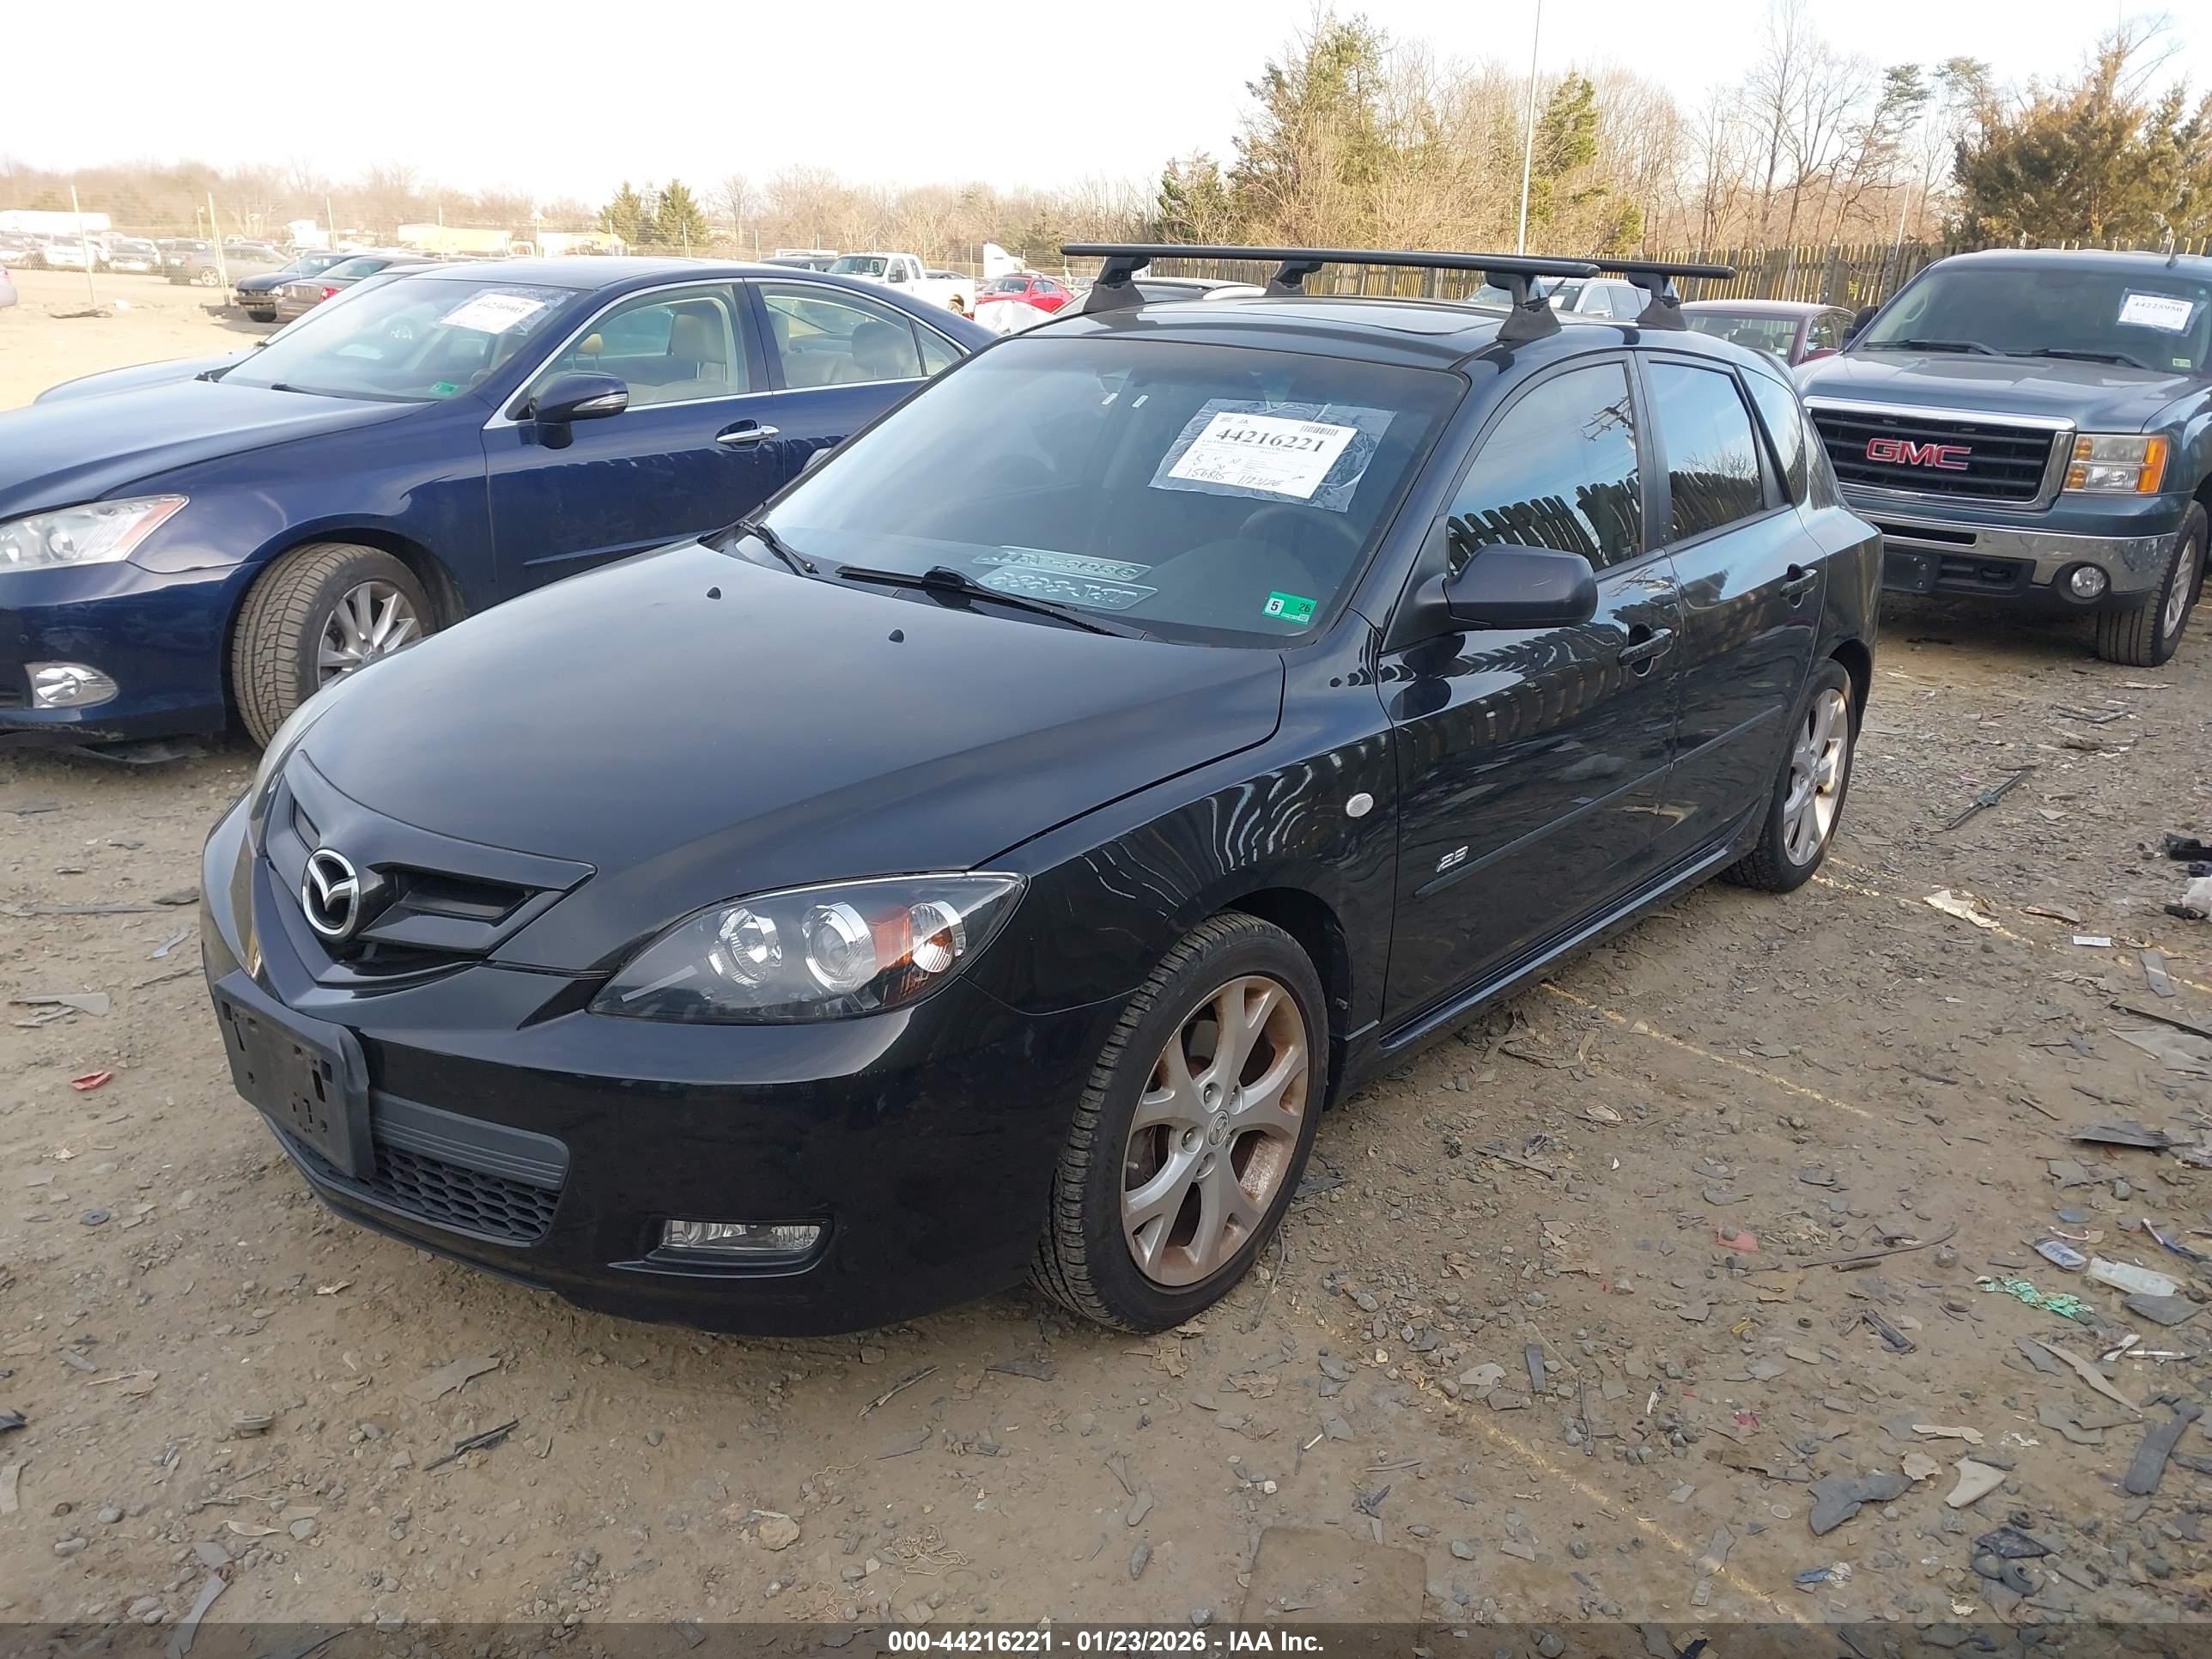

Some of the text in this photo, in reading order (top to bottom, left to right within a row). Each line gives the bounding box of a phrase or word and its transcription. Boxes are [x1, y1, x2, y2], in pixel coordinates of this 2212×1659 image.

[1215, 428, 1326, 453] 44216221
[1866, 437, 1972, 471] GMC
[1270, 600, 1312, 613] 5 26
